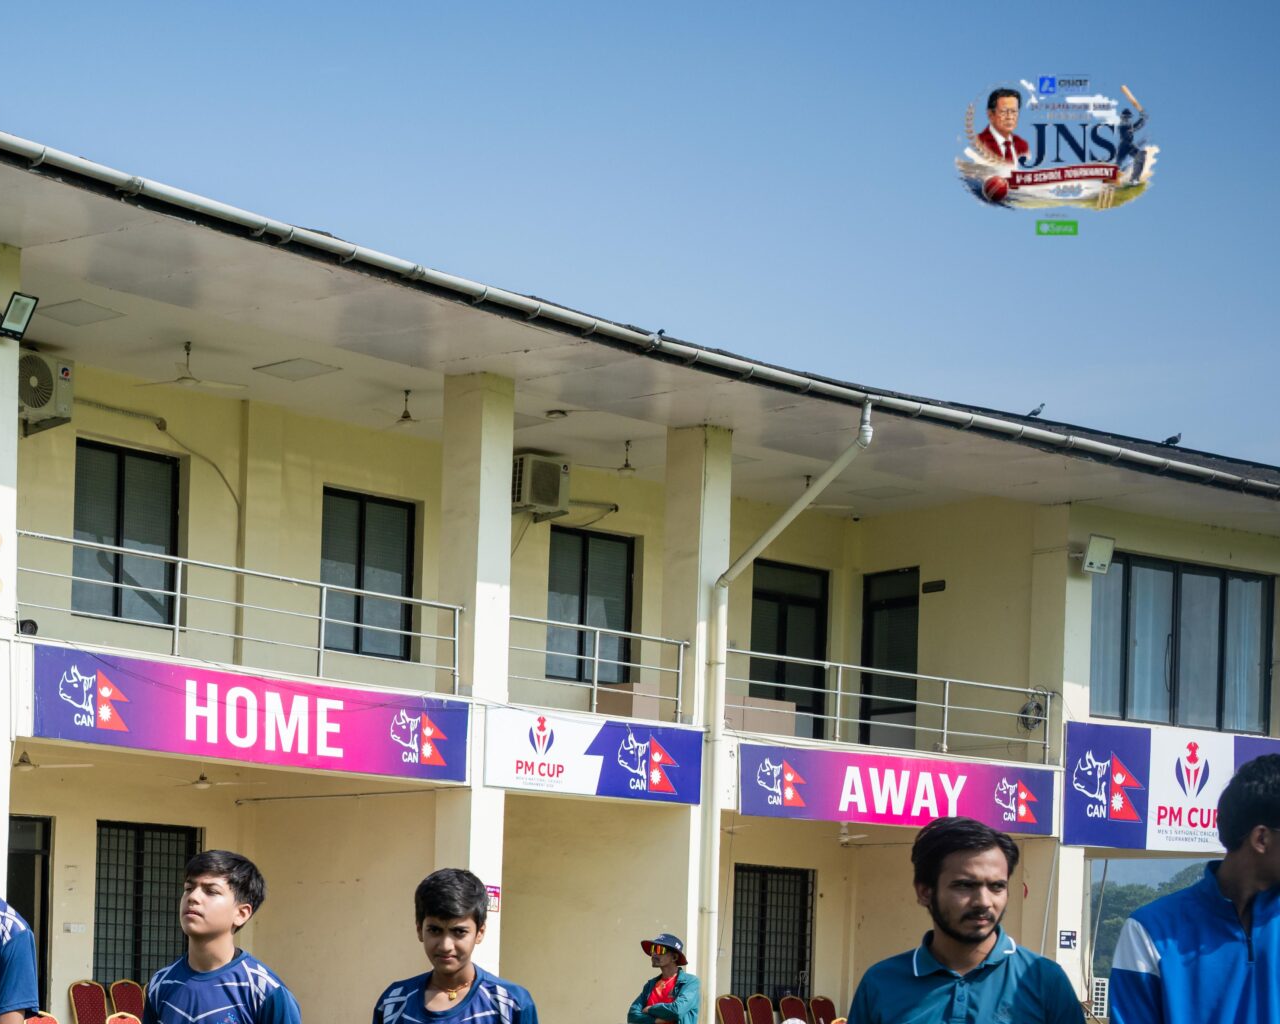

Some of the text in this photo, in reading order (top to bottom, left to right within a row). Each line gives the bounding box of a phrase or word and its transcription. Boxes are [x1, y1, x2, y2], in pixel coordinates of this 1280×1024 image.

[74, 713, 94, 728] CAN
[185, 679, 344, 758] HOME
[402, 751, 419, 764] CAN
[515, 759, 565, 778] PM CUP
[629, 776, 647, 791] CAN
[838, 765, 968, 818] AWAY
[767, 794, 782, 806] CAN
[1003, 811, 1016, 822] CAN
[1086, 803, 1107, 819] CAN
[1157, 805, 1183, 827] PM
